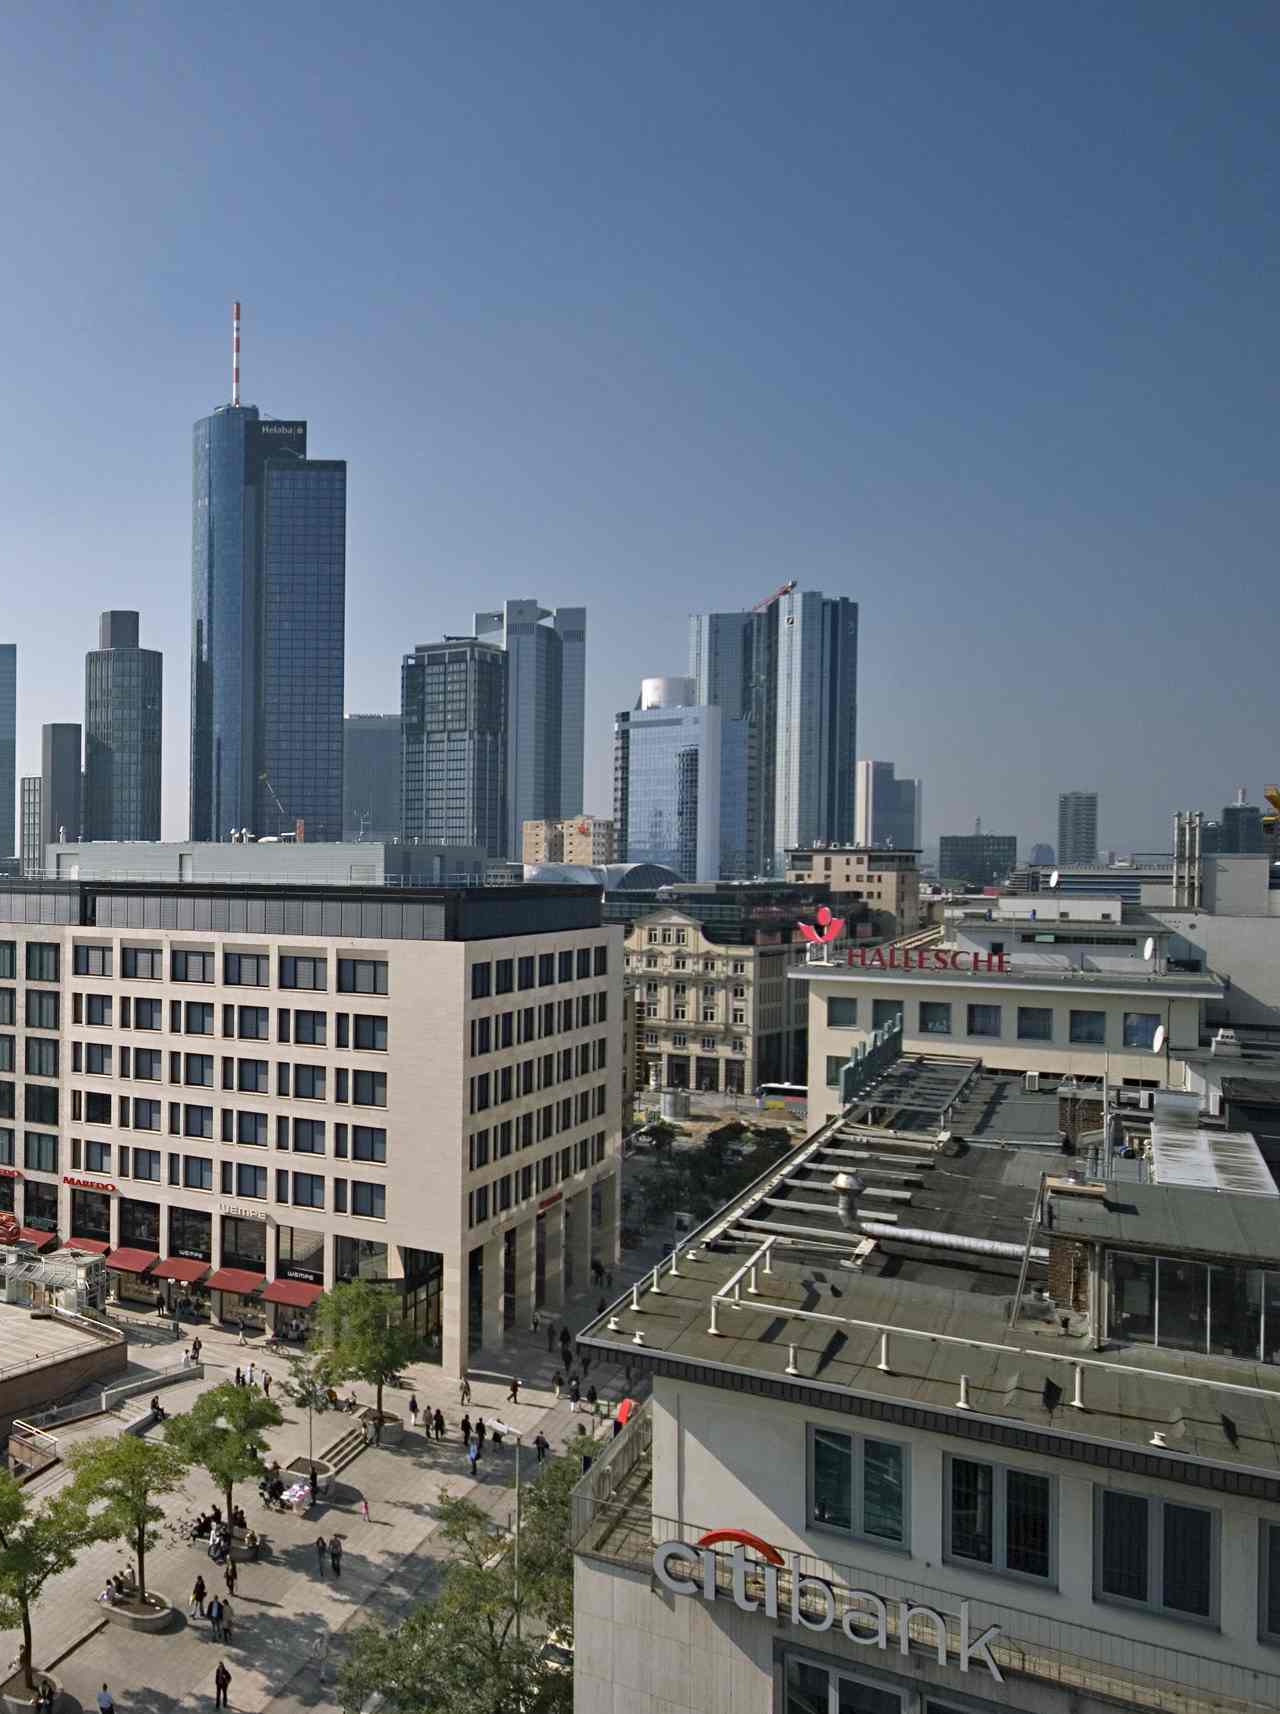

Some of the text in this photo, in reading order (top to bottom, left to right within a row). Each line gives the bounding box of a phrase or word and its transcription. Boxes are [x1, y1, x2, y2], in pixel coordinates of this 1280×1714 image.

[261, 424, 293, 434] Helaba
[847, 945, 1012, 973] HALLESCHE
[63, 1176, 116, 1192] MAREDO
[652, 1538, 1006, 1683] citibank
